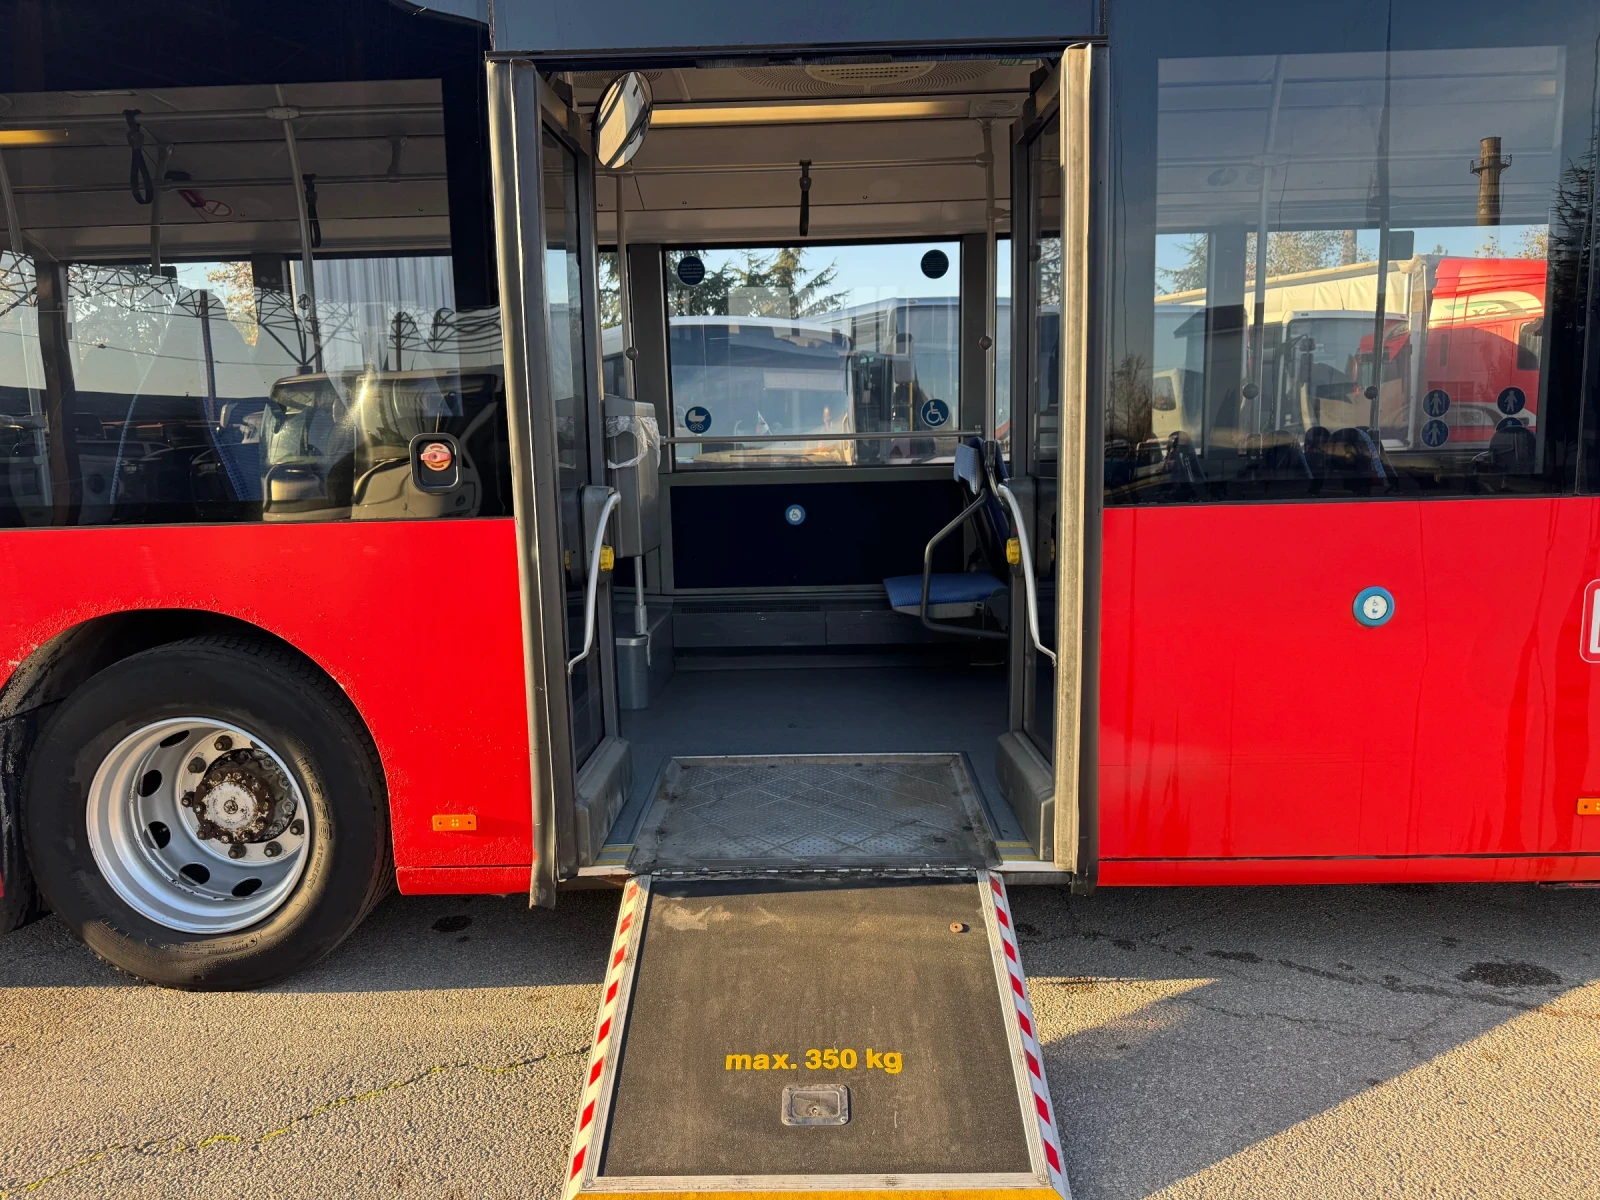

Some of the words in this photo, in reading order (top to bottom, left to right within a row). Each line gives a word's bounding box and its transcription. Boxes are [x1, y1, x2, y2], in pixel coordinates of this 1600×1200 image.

[725, 1053, 797, 1070] max.
[805, 1048, 857, 1069] 350
[866, 1048, 904, 1074] kg
